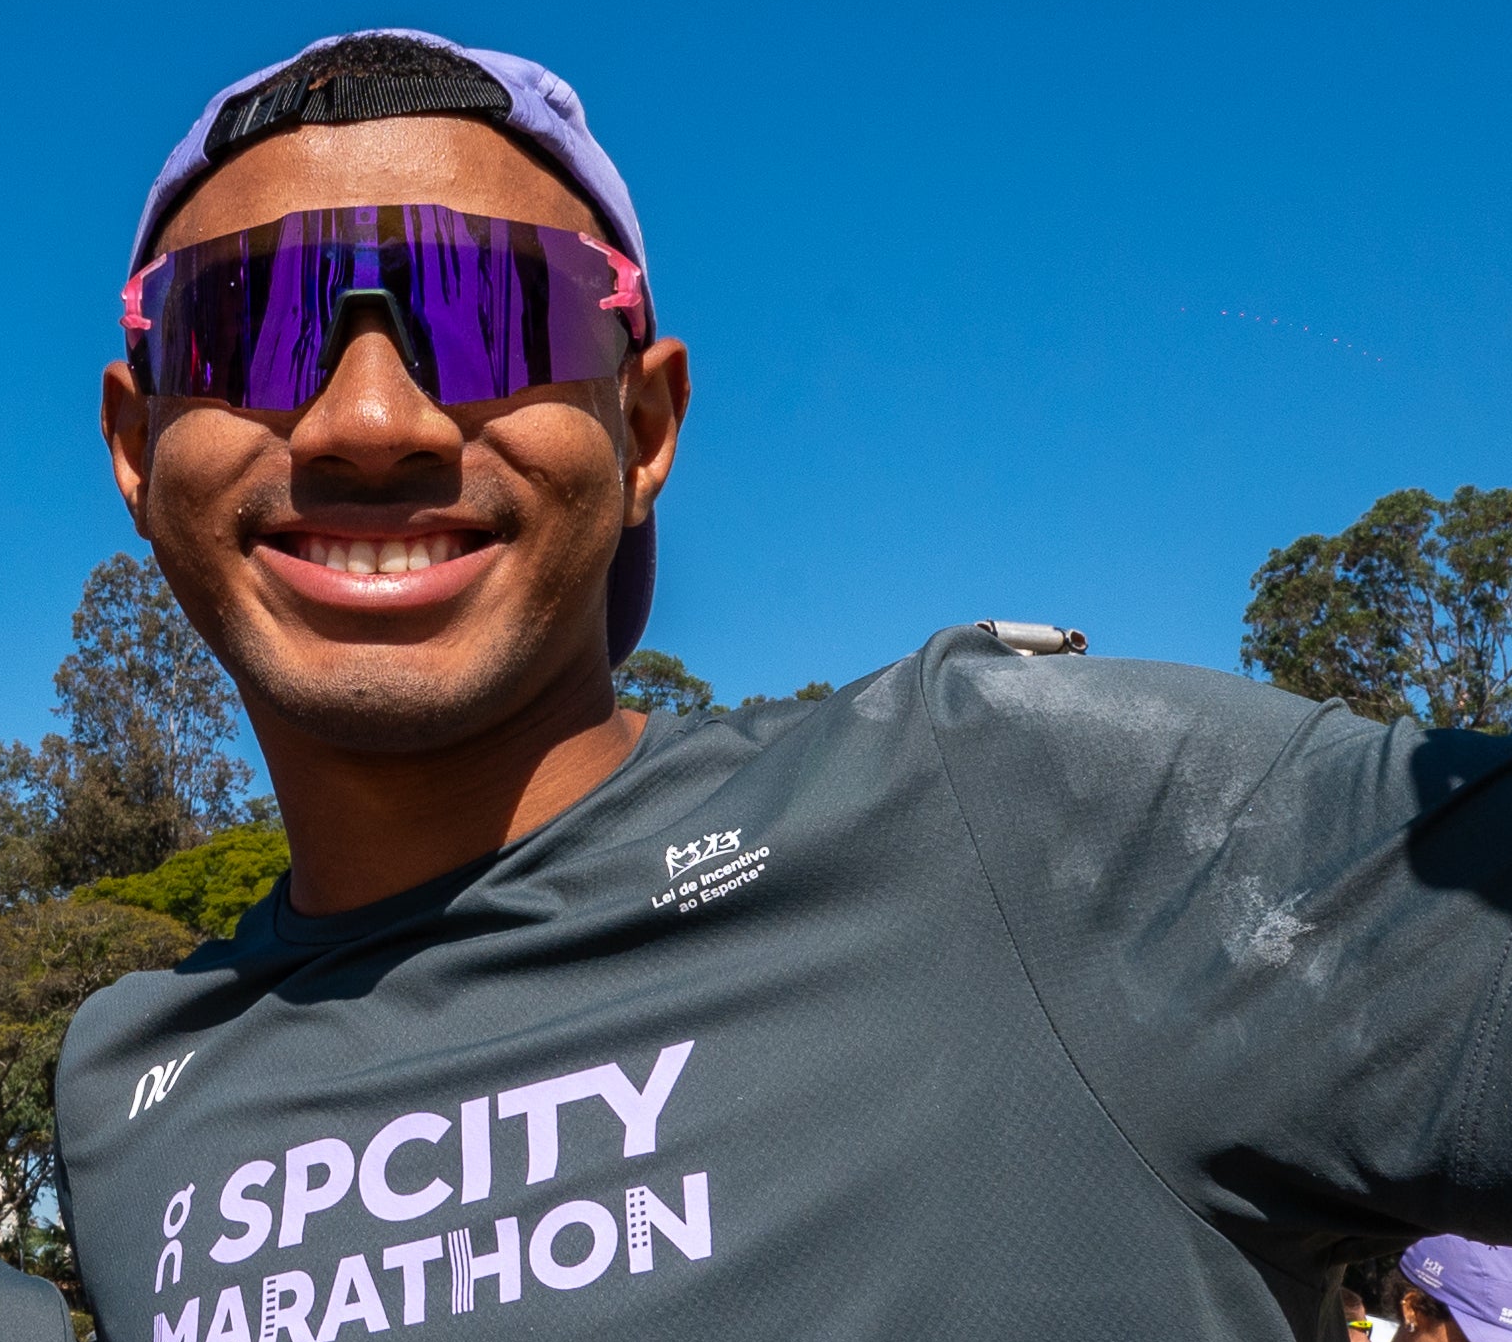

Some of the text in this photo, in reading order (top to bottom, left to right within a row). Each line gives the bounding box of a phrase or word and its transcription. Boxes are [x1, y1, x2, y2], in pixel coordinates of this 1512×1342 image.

[652, 846, 770, 908] Lei de Incentivo
[679, 898, 697, 913] ao
[207, 1039, 696, 1265] SPCITY
